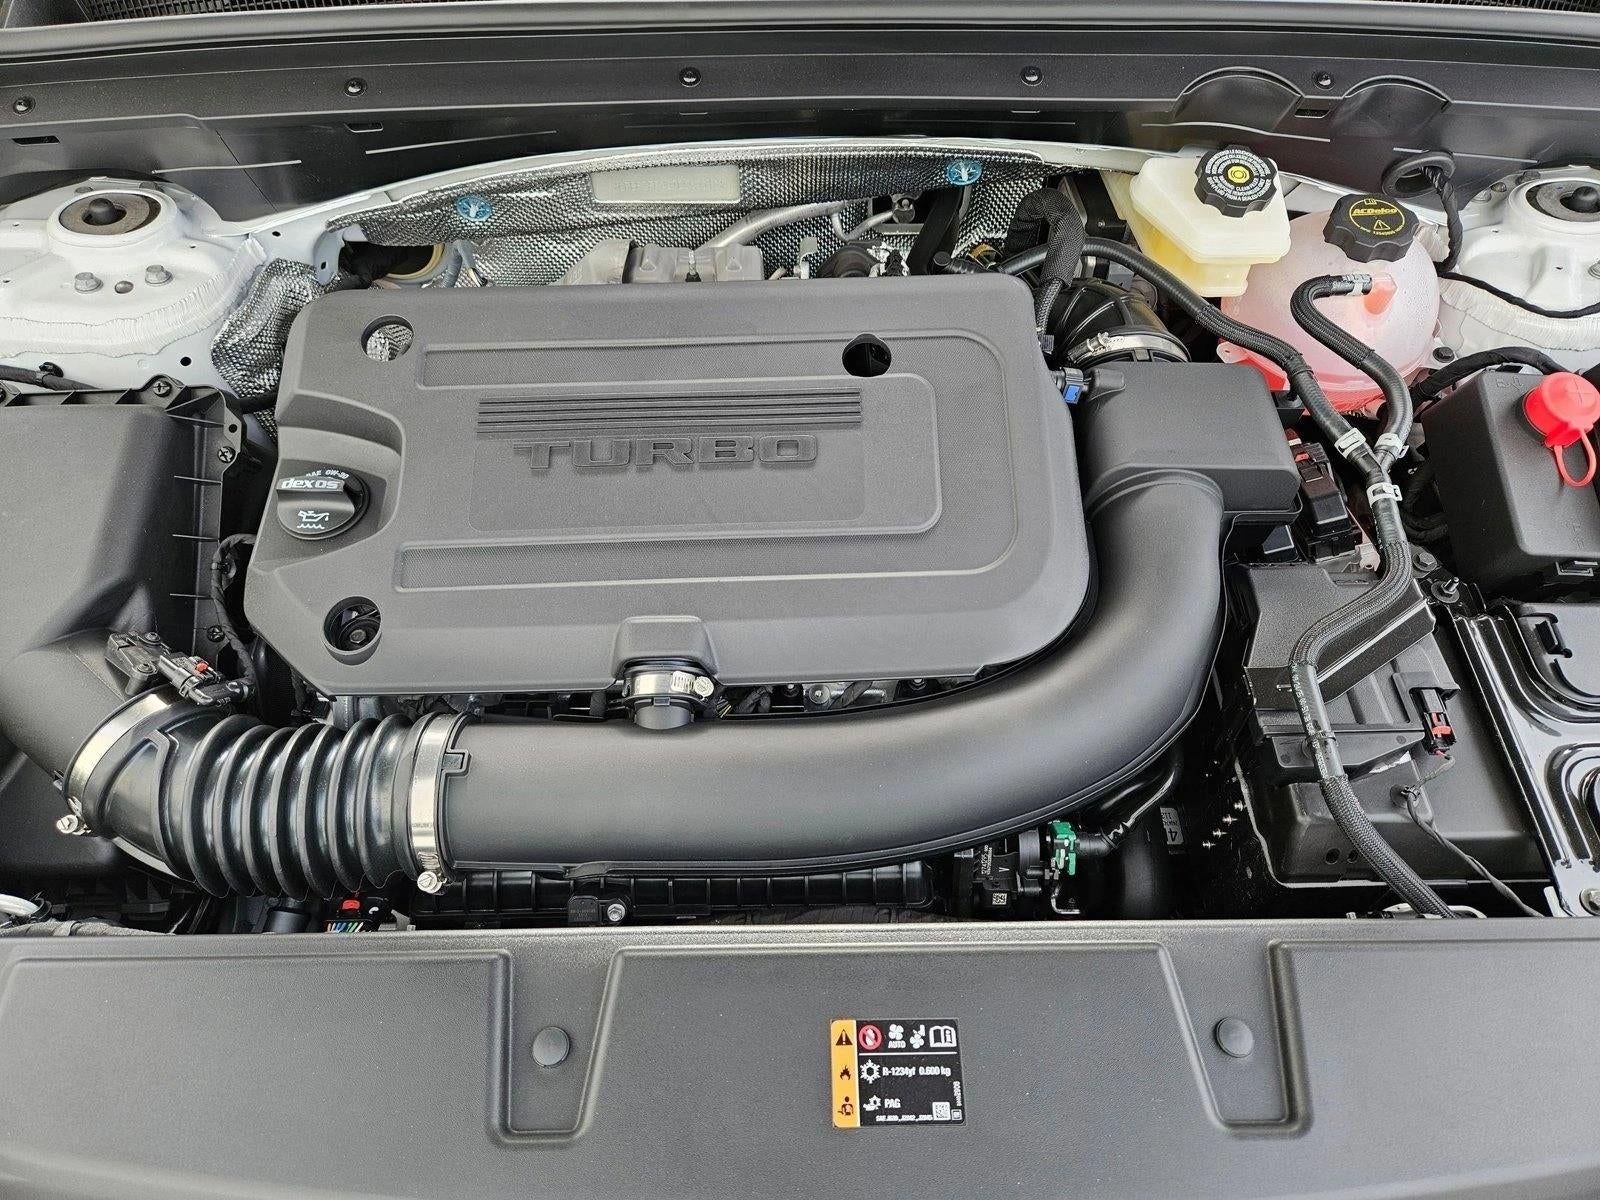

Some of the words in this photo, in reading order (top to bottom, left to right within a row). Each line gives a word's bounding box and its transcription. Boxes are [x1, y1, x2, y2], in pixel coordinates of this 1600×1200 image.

[1352, 208, 1398, 216] ACDelco
[512, 434, 819, 469] TURBO
[281, 478, 340, 489] dexos
[888, 1040, 907, 1049] AUTO
[941, 1066, 951, 1077] kg
[884, 1098, 901, 1109] PAG
